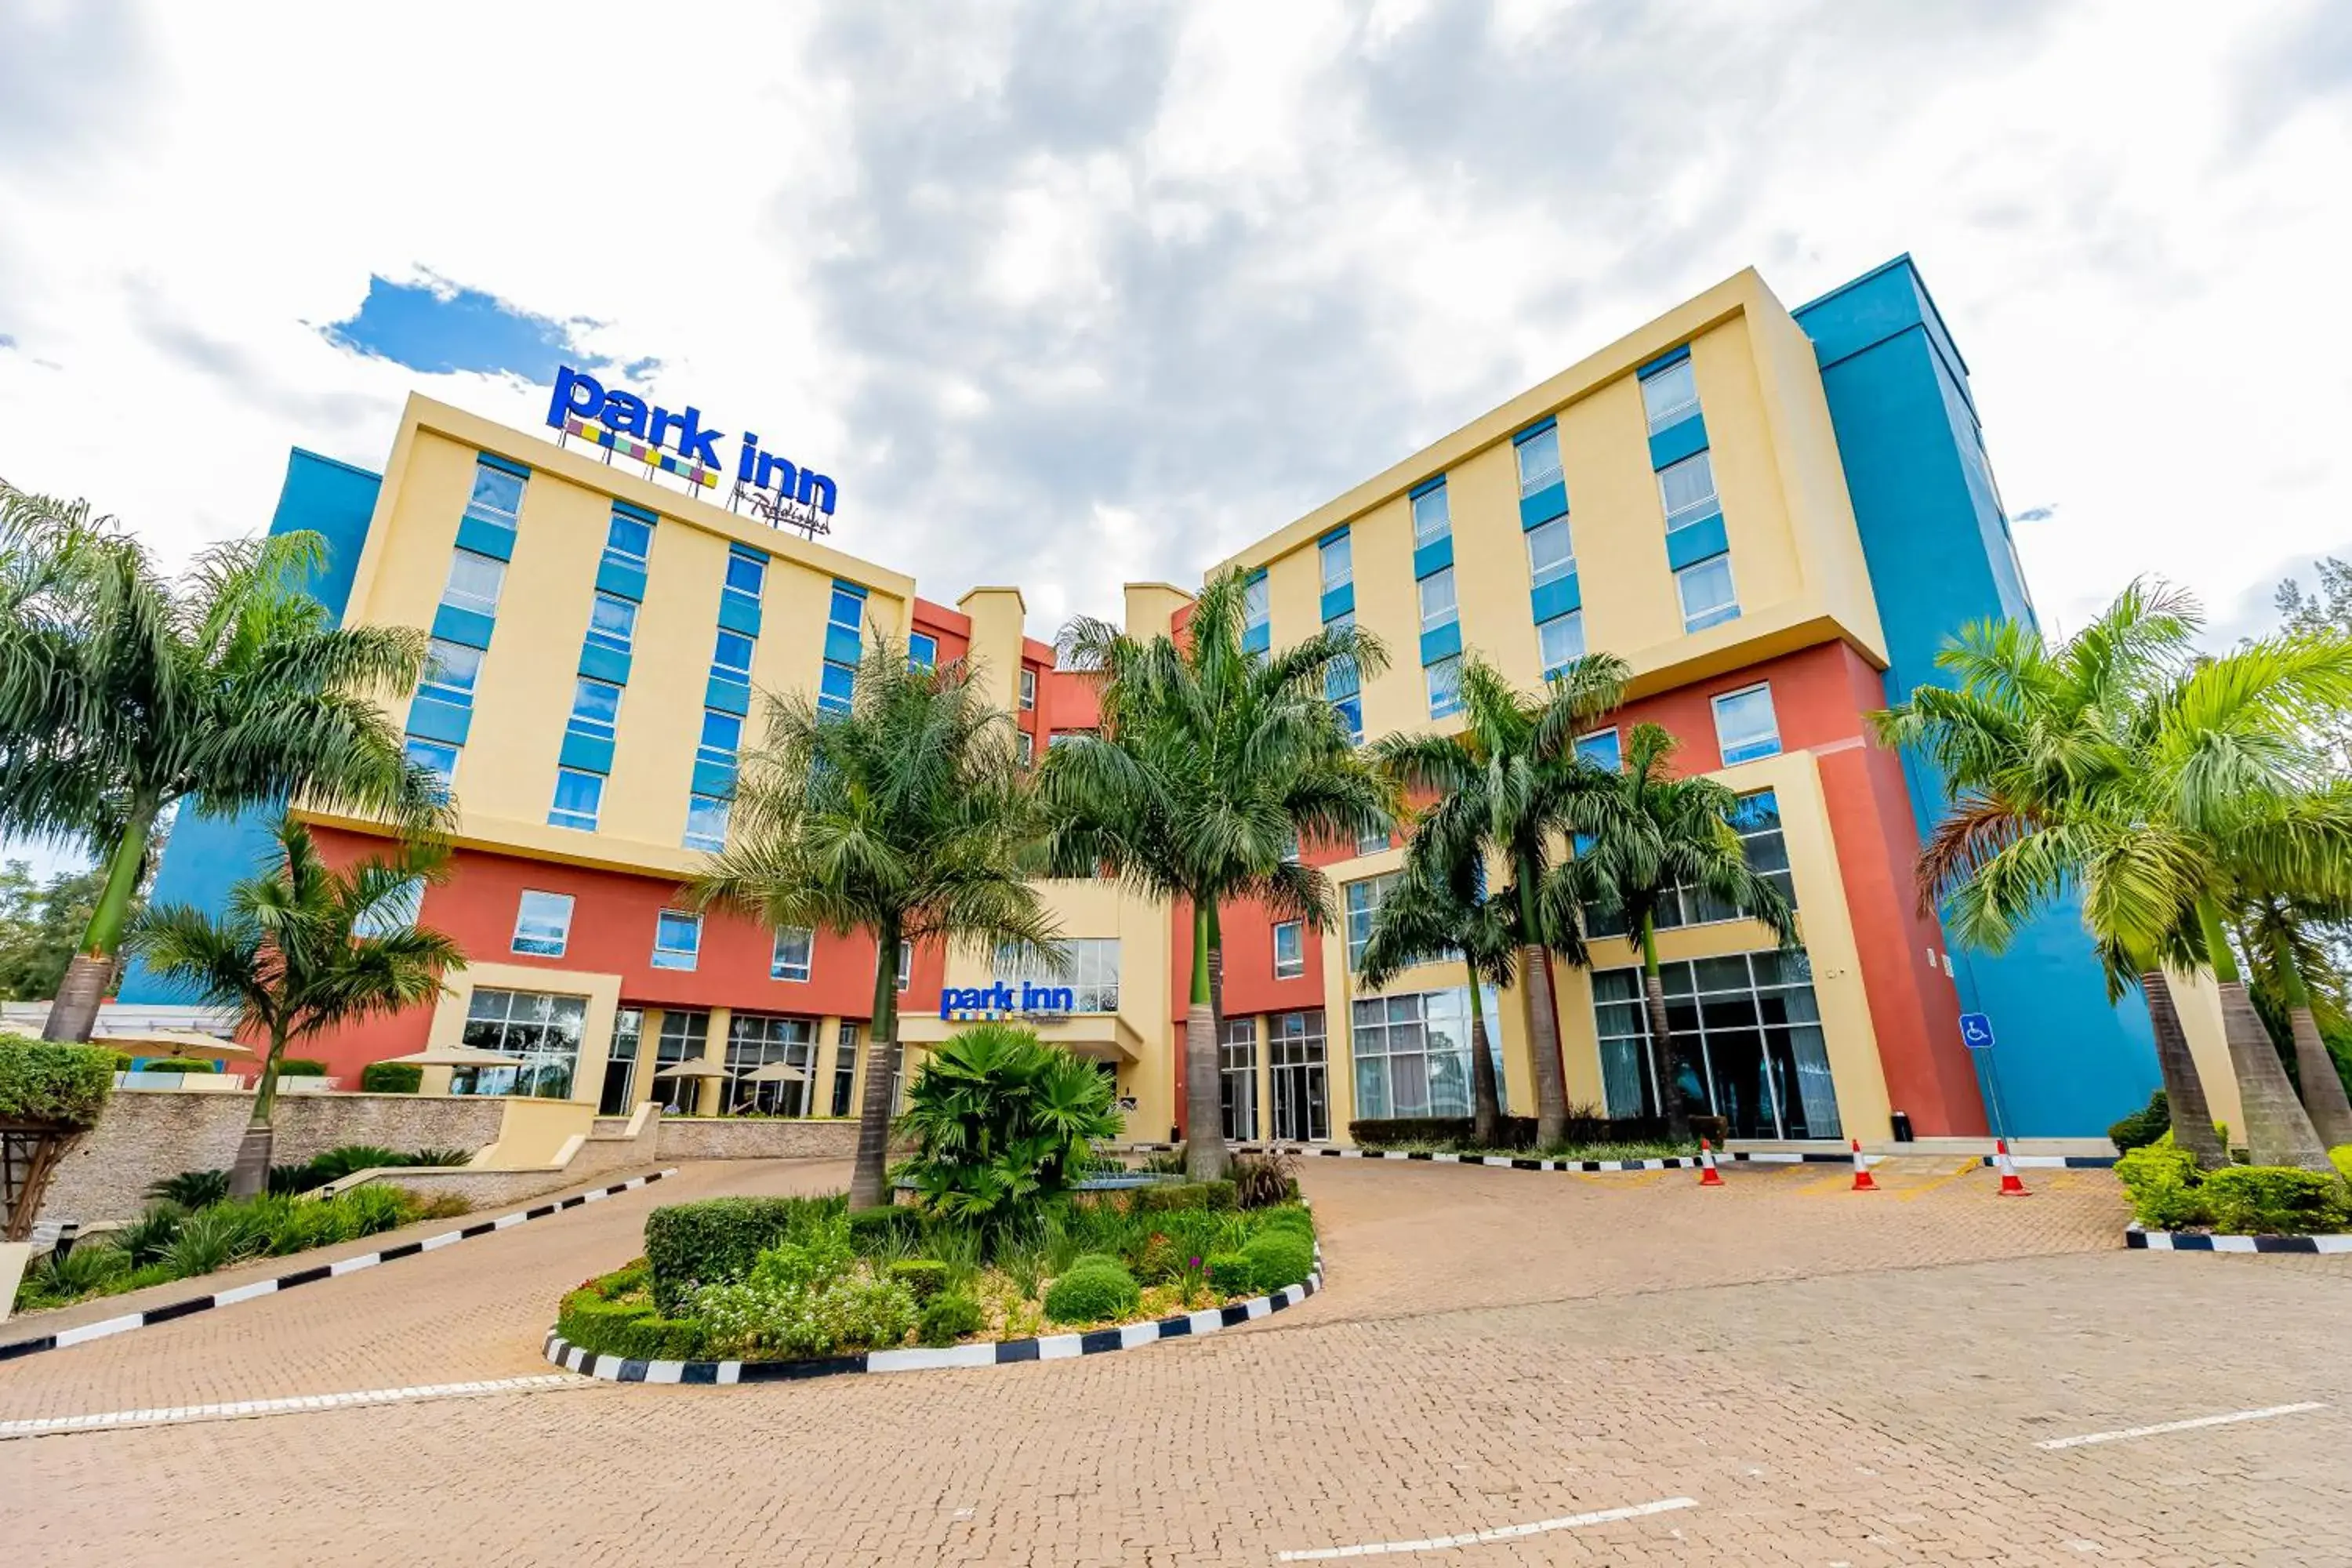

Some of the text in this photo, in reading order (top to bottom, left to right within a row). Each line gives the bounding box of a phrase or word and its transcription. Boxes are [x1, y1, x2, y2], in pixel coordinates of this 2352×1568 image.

[546, 365, 837, 515] park inn
[940, 981, 1014, 1020] park
[1022, 981, 1073, 1011] inn
